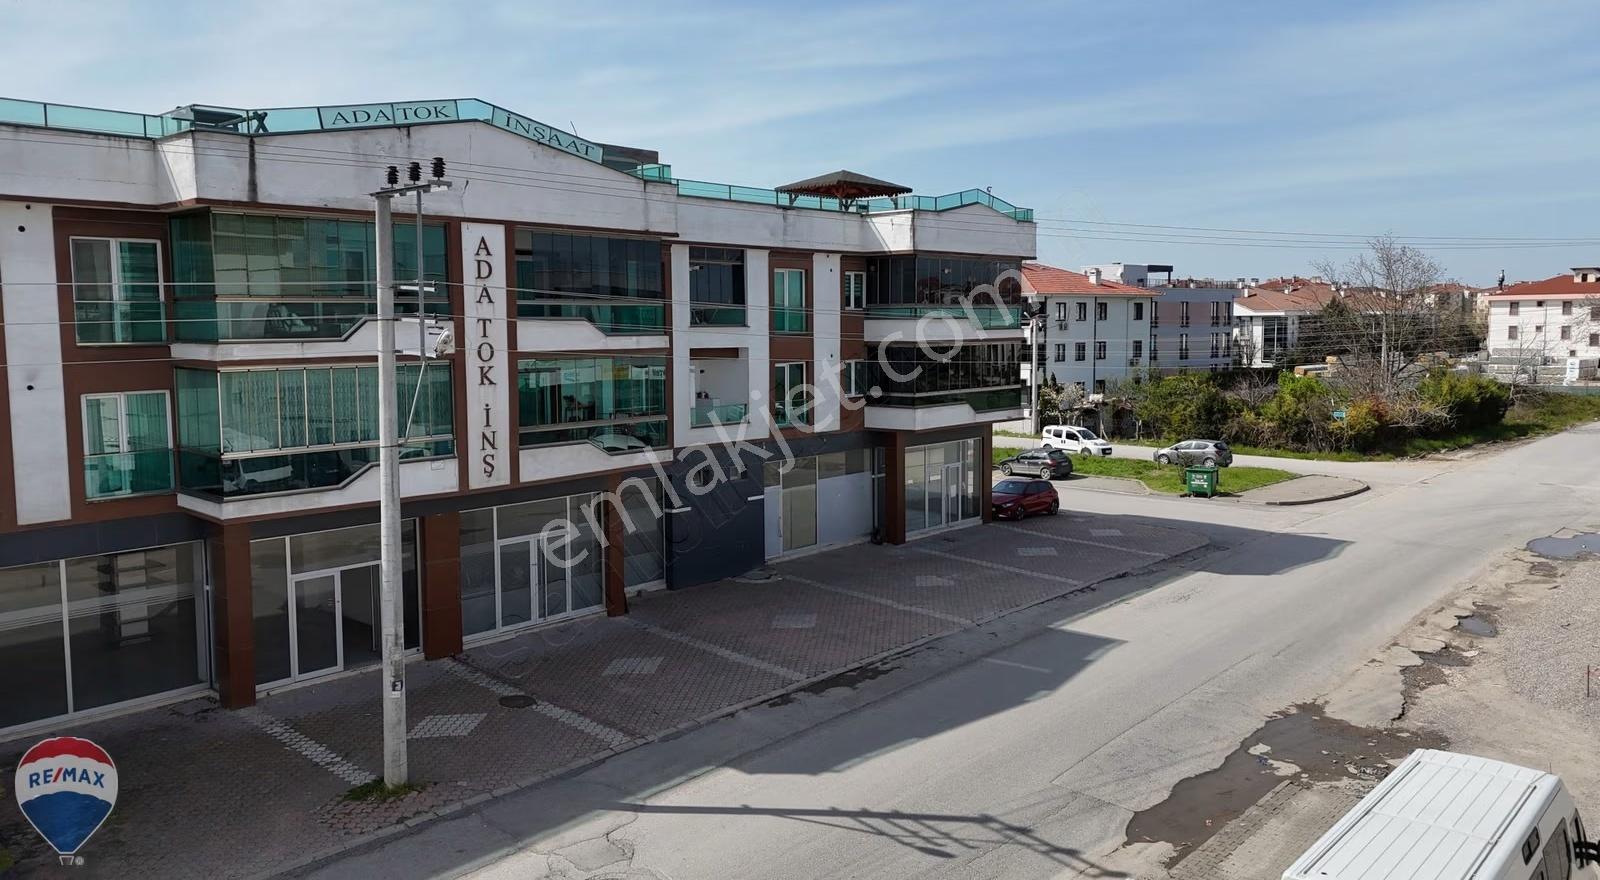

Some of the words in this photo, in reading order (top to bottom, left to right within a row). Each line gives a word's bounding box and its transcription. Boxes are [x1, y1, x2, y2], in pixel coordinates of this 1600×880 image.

[332, 107, 392, 125] ADA
[397, 104, 450, 121] TOK
[504, 112, 595, 157] İNŞAAT
[474, 236, 494, 304] ADA
[477, 318, 497, 386] TOK
[481, 403, 498, 478] İNŞ
